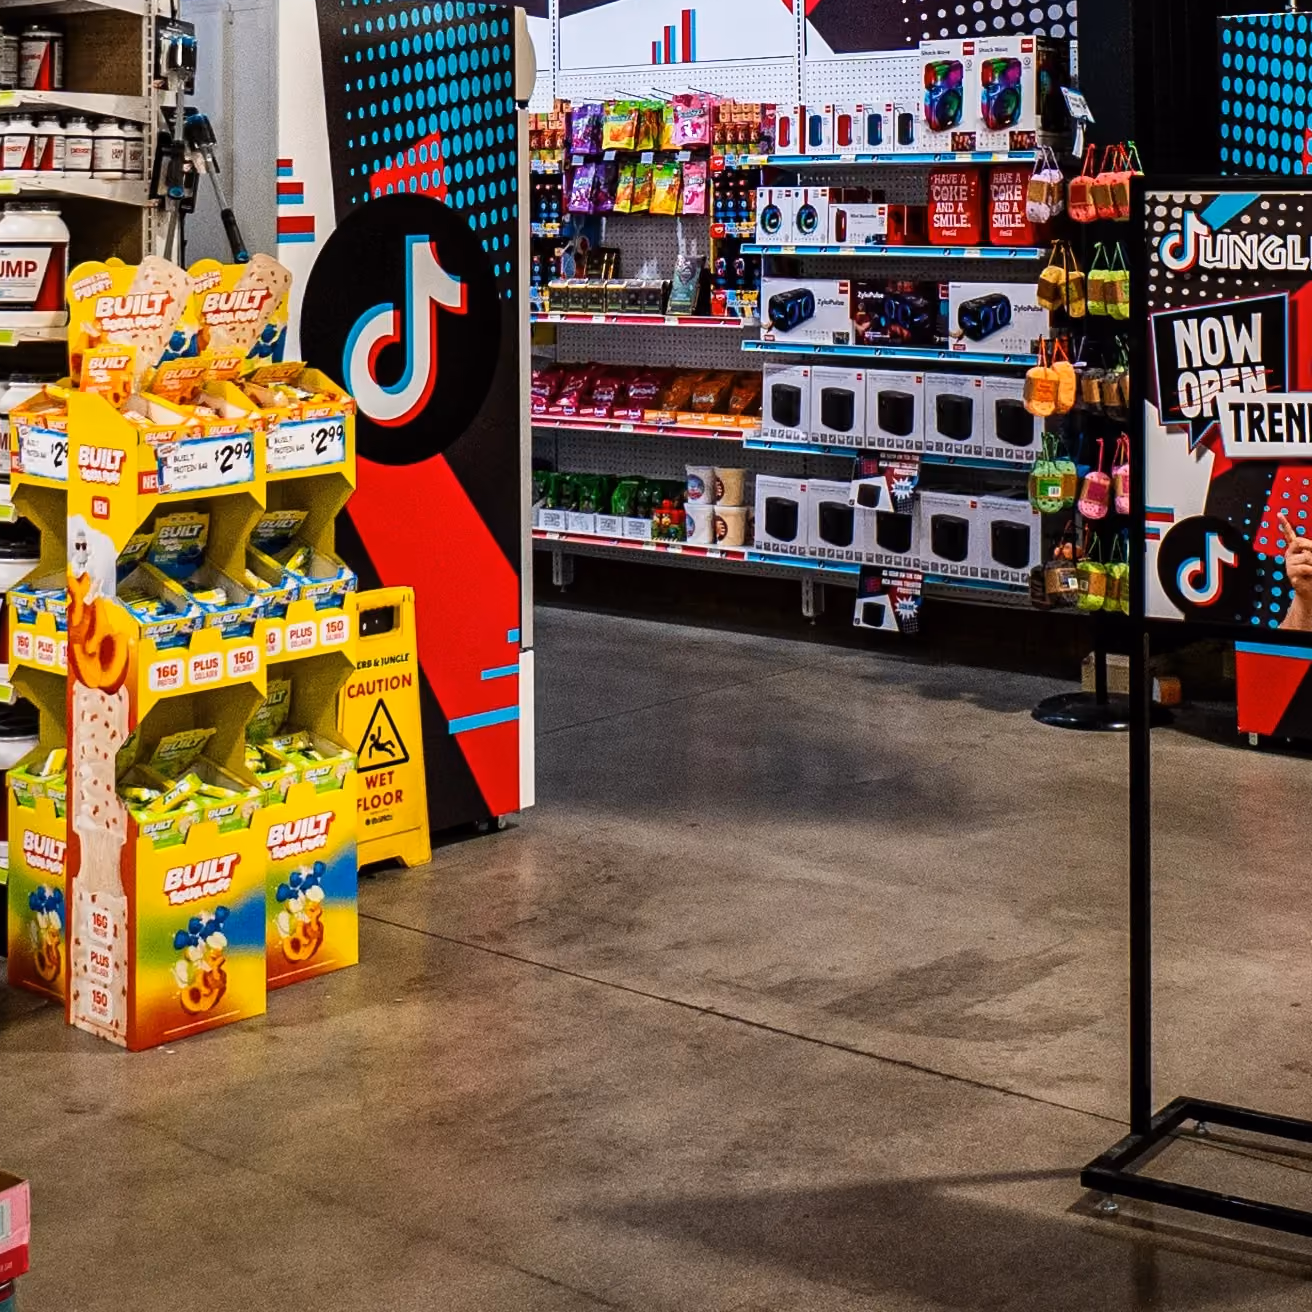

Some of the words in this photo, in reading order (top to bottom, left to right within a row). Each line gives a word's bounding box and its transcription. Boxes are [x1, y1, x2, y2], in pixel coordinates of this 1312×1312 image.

[934, 173, 960, 185] HAVE
[960, 173, 968, 184] A
[993, 172, 1014, 184] HAVE
[1015, 172, 1022, 184] A
[932, 185, 969, 202] COKE
[991, 184, 1023, 201] COKE
[935, 202, 955, 214] AND
[957, 202, 964, 214] A
[994, 201, 1012, 214] AND
[1012, 201, 1019, 214] A
[933, 213, 971, 229] SMILE.
[992, 213, 1025, 228] SMILE.
[95, 291, 170, 318] BUILT
[202, 288, 269, 313] BUILT
[1173, 311, 1262, 370] NOW
[89, 356, 130, 371] BUILT
[78, 444, 126, 470] BUILT
[158, 524, 203, 539] BUILT
[289, 627, 313, 640] PLUS
[326, 620, 344, 633] 150
[38, 640, 53, 654] PLUS
[156, 663, 178, 678] 16G
[193, 657, 219, 672] PLUS
[233, 650, 254, 664] 150
[380, 652, 410, 667] JUNGLE
[347, 672, 413, 699] CAUTION
[365, 770, 394, 790] WET
[357, 789, 404, 813] FLOOR
[267, 811, 334, 848] BUILT
[23, 829, 66, 855] BUILT
[164, 853, 238, 892] BUILT
[91, 912, 108, 928] 16G
[90, 951, 109, 967] PLUS
[91, 990, 108, 1007] 150
